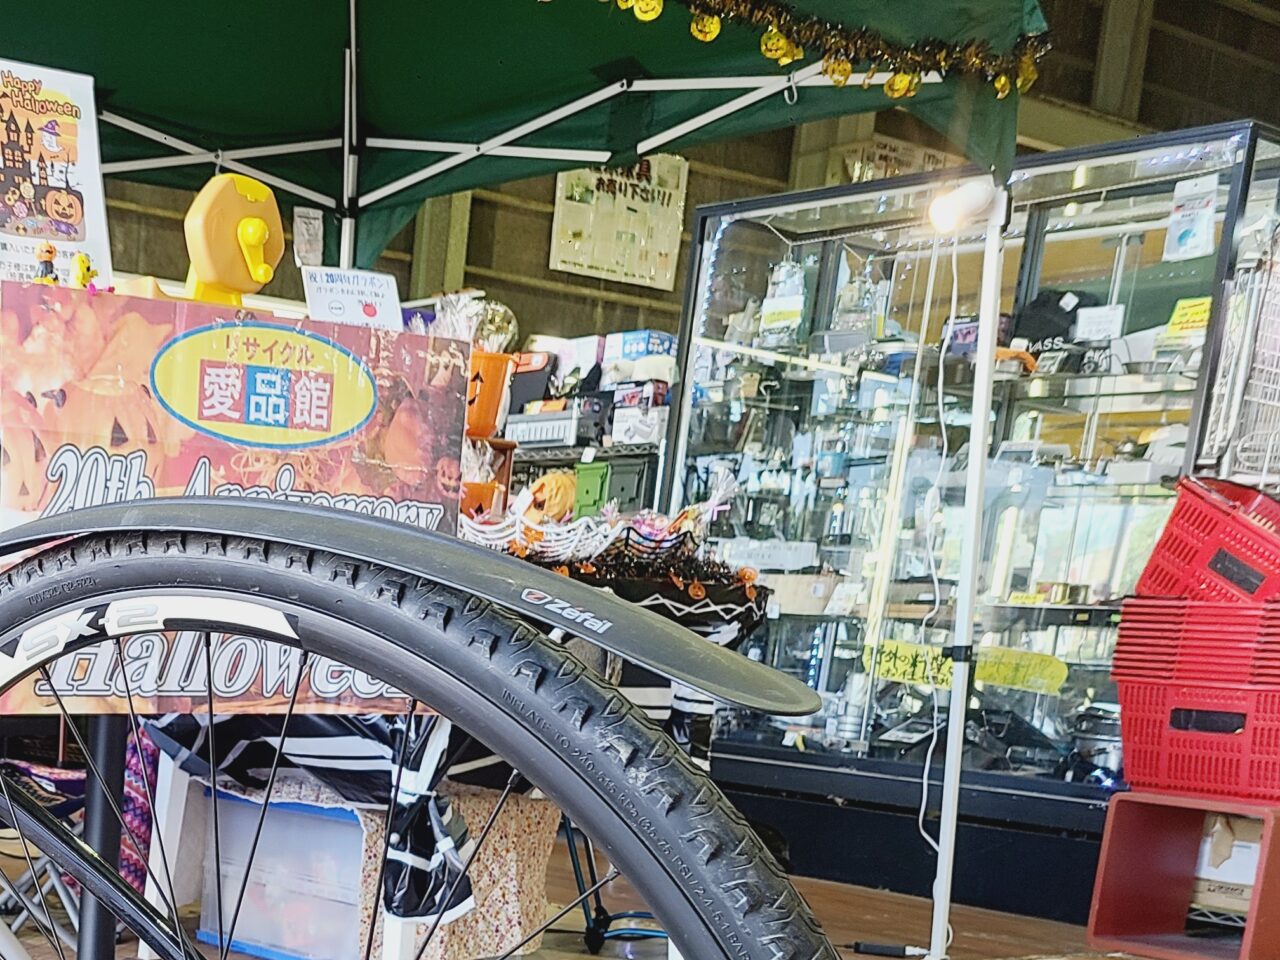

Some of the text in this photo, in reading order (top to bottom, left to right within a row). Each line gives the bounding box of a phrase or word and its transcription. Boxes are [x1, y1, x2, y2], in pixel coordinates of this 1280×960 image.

[1, 70, 43, 95] Happy
[10, 90, 82, 119] Halloween
[226, 334, 315, 364] リサイクル
[202, 366, 330, 428] 愛品館
[23, 603, 158, 662] SX-2
